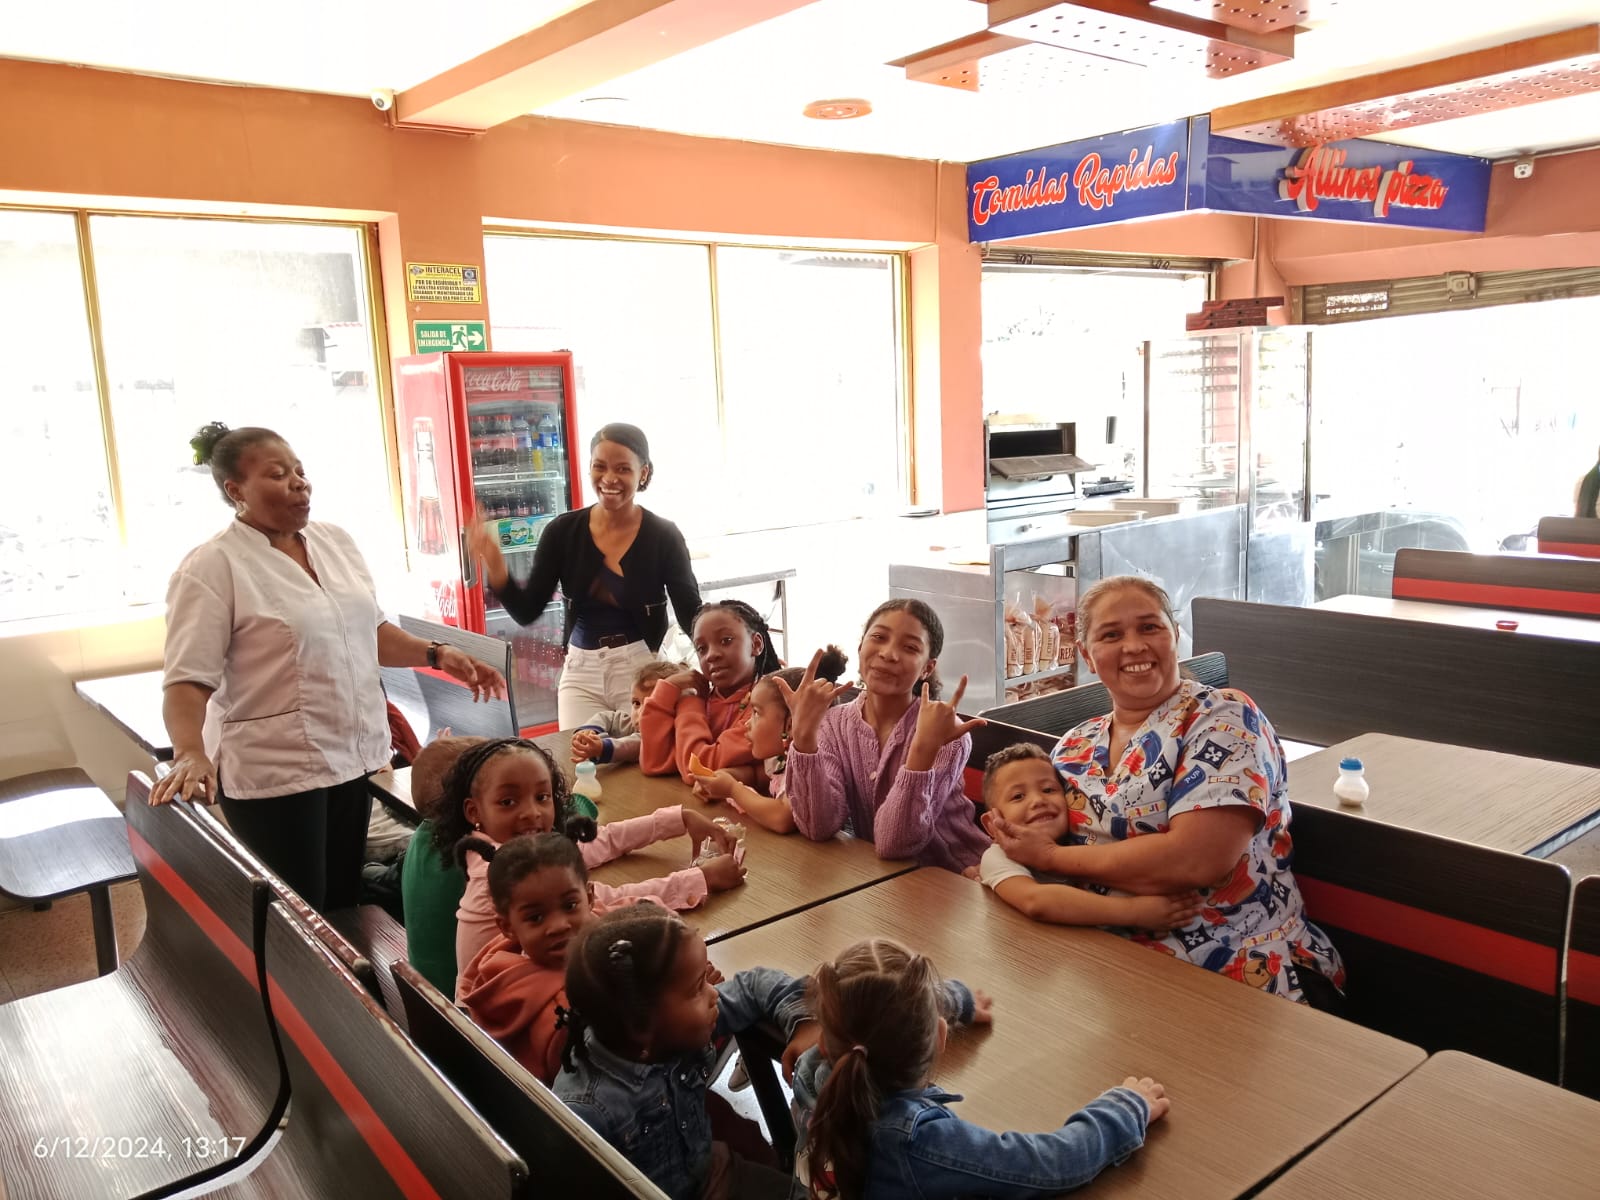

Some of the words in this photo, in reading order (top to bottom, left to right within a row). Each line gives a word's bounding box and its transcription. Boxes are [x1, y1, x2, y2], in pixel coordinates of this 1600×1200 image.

[973, 167, 1069, 225] Comidas
[1073, 145, 1179, 210] Rapidas
[1373, 160, 1449, 218] pizza
[1184, 769, 1200, 784] PUP
